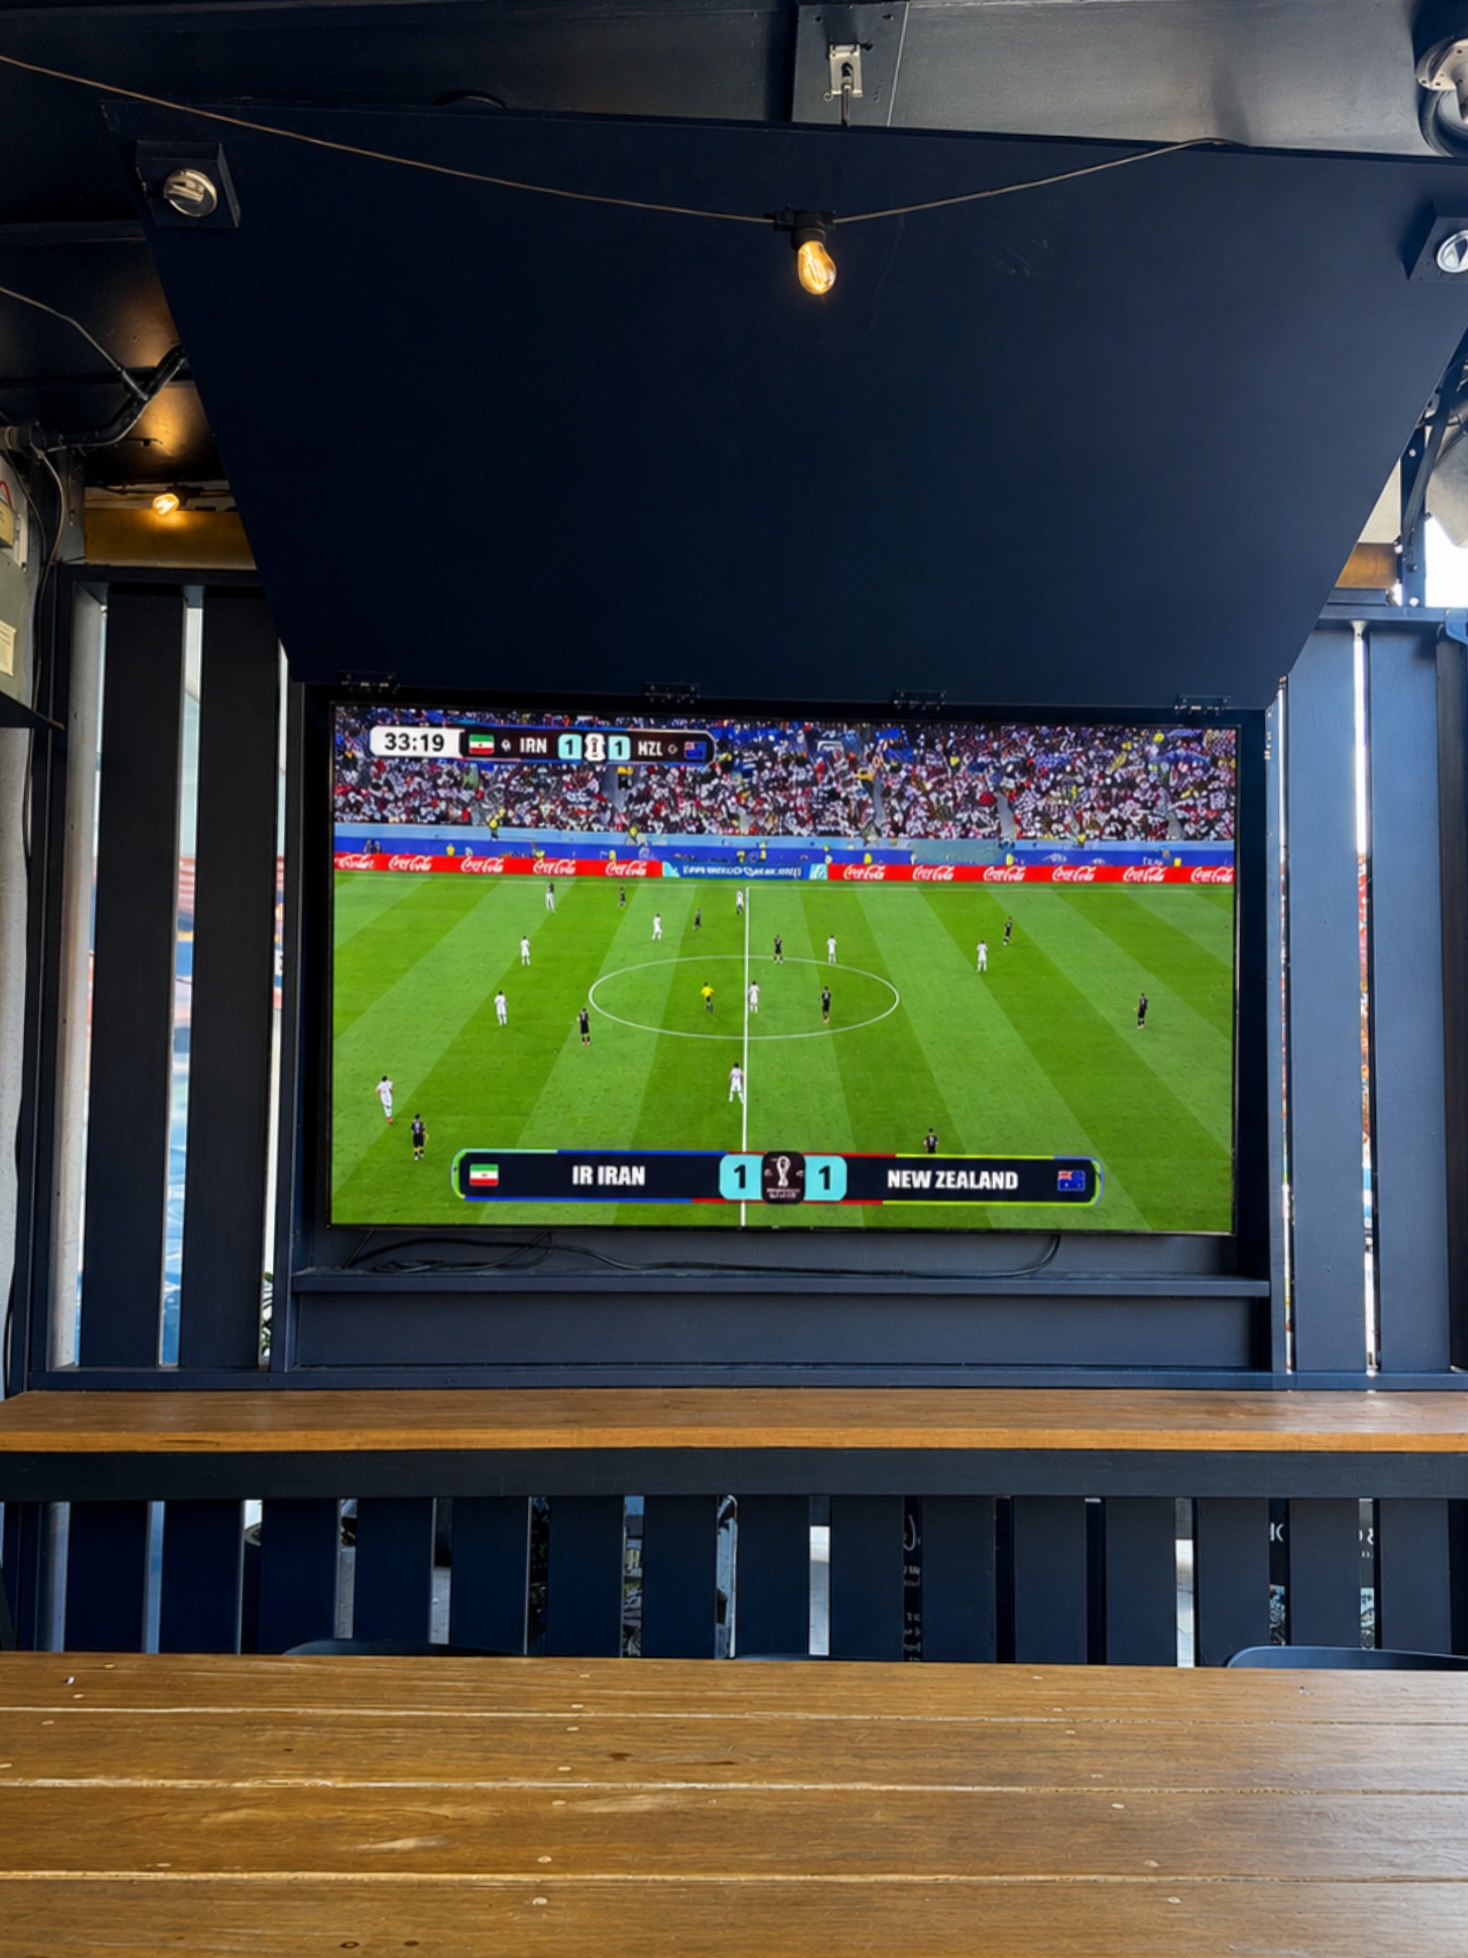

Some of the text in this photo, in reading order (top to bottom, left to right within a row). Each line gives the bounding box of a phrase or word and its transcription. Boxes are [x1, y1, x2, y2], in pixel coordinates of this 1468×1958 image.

[384, 732, 445, 752] 33:19
[520, 737, 547, 753] IRN
[565, 738, 574, 756] 1
[614, 740, 623, 757] 1
[638, 740, 663, 757] NZL
[572, 1164, 1019, 1191] IR IRAN 1 1 NEW ZEALAND
